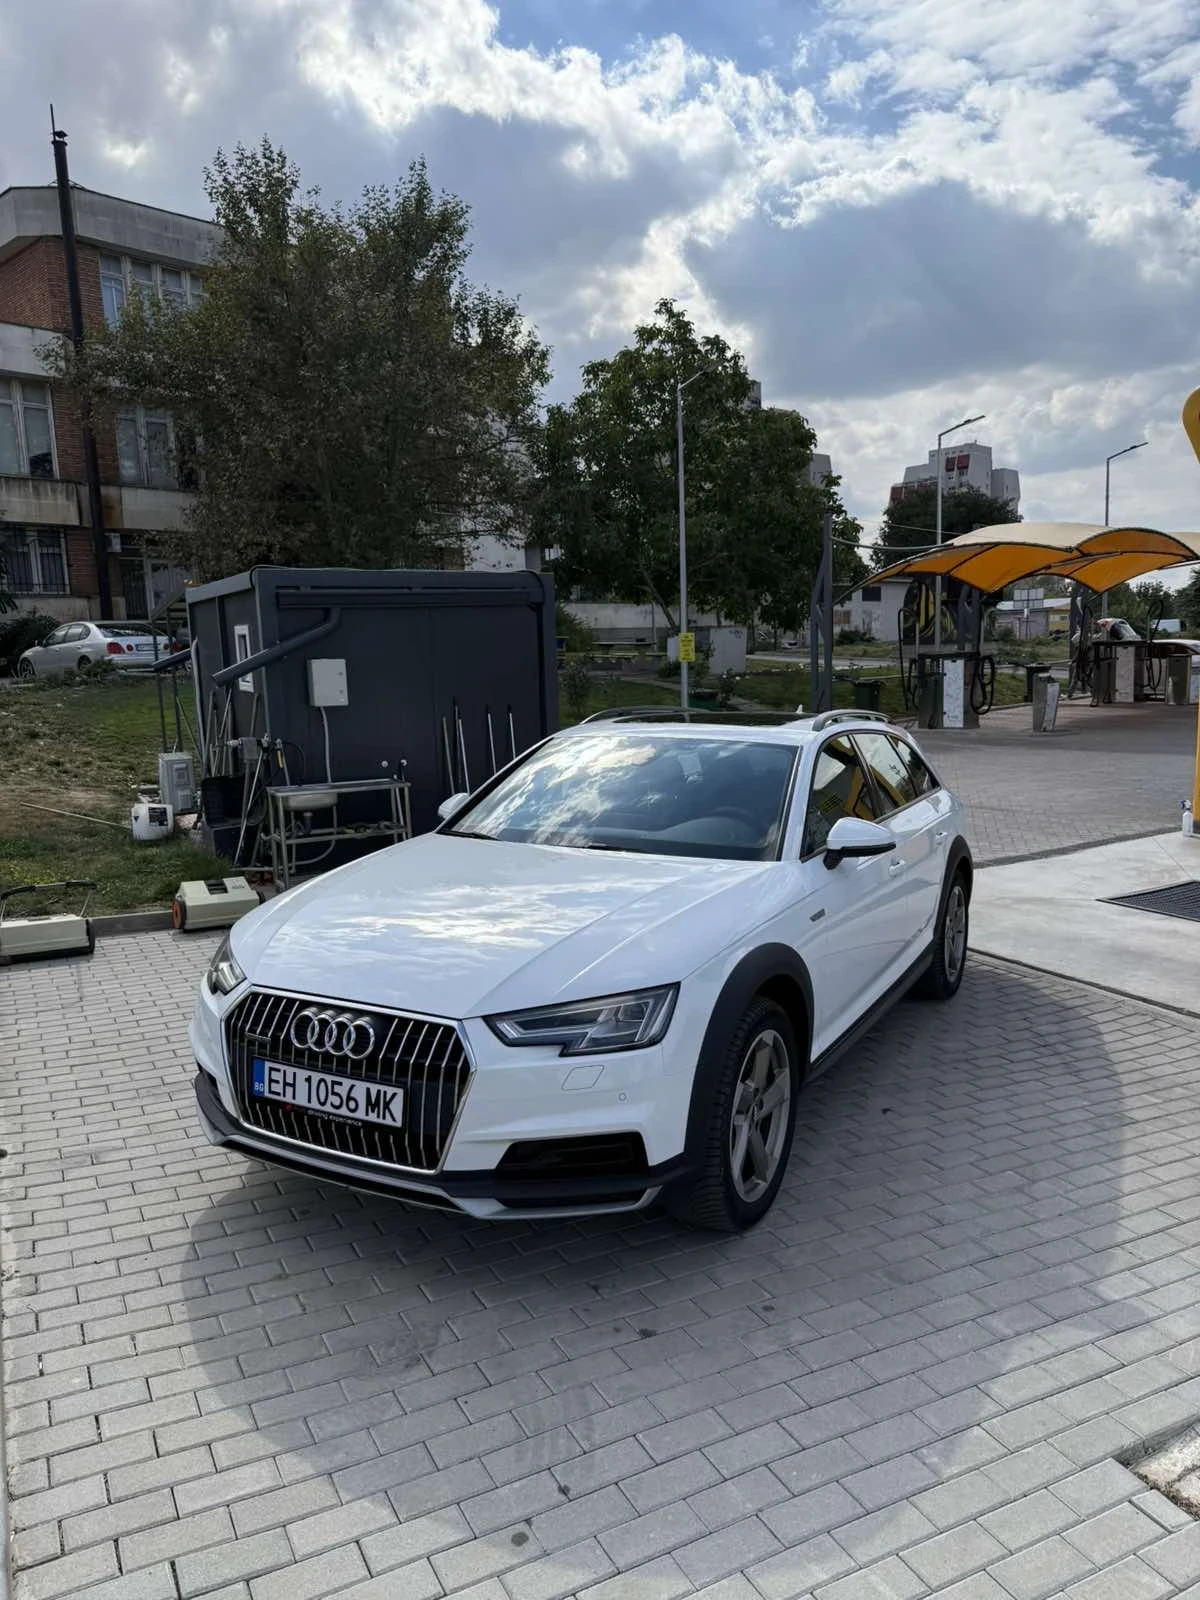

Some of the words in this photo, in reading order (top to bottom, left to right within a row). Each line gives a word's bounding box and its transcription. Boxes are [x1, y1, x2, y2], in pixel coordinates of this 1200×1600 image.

[254, 1083, 265, 1093] BG
[267, 1067, 297, 1101] EH
[304, 1075, 359, 1113] 1056
[365, 1086, 398, 1122] MK
